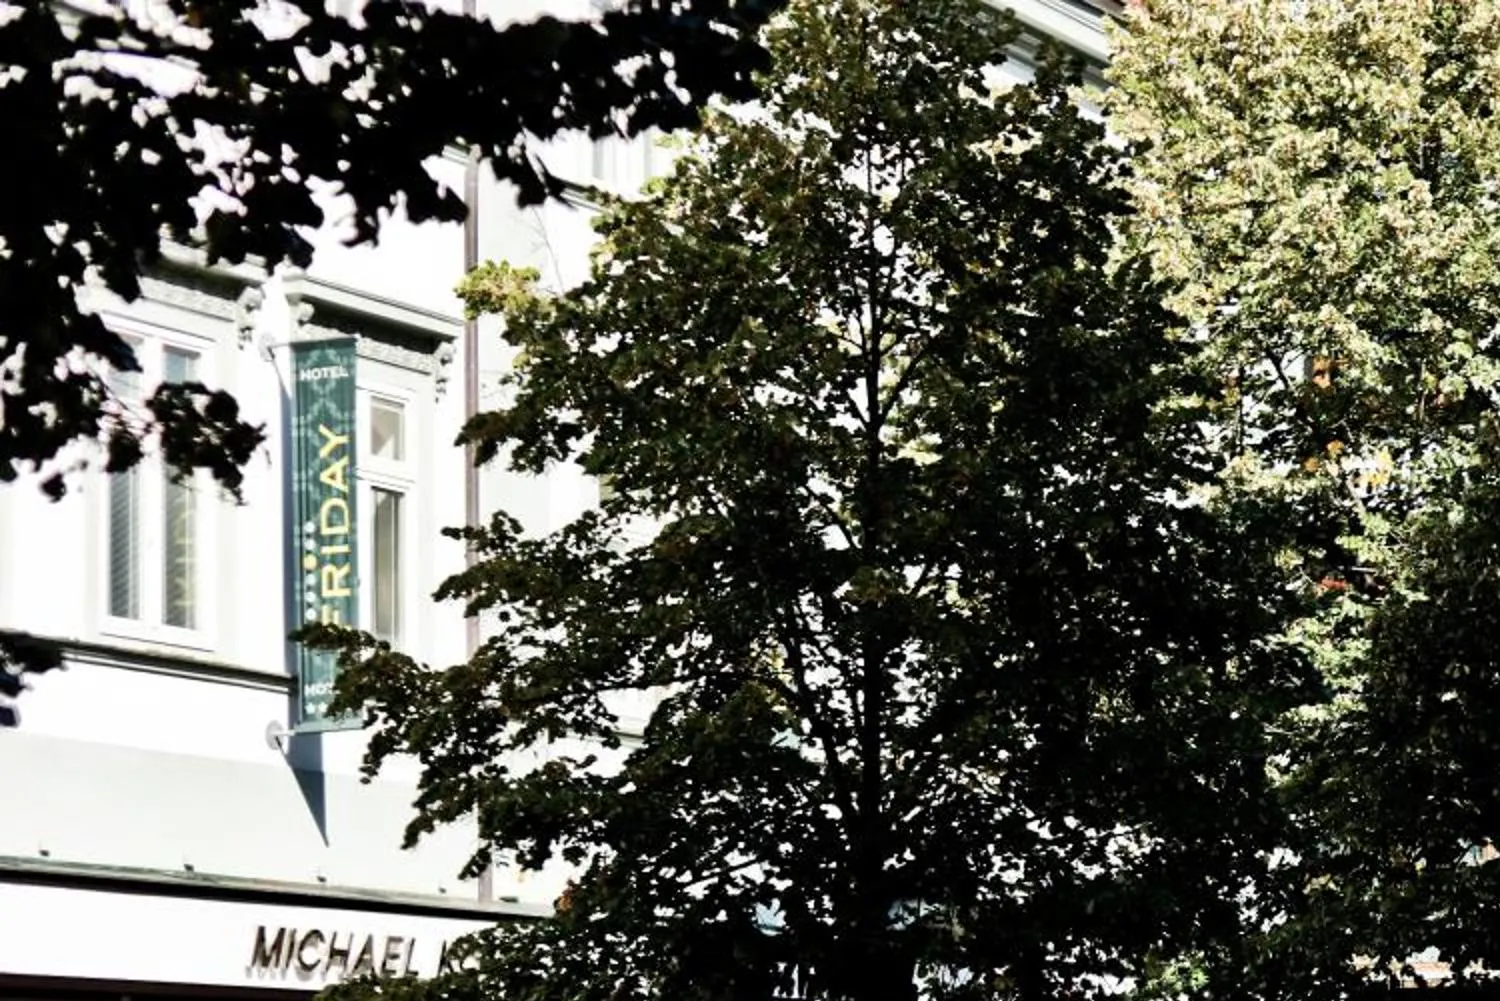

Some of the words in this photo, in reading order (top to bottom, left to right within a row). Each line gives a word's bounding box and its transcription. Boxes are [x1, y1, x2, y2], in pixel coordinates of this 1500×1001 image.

[300, 366, 349, 381] HOTEL
[319, 423, 351, 629] FRIDAY
[252, 925, 419, 978] MICHAEL
